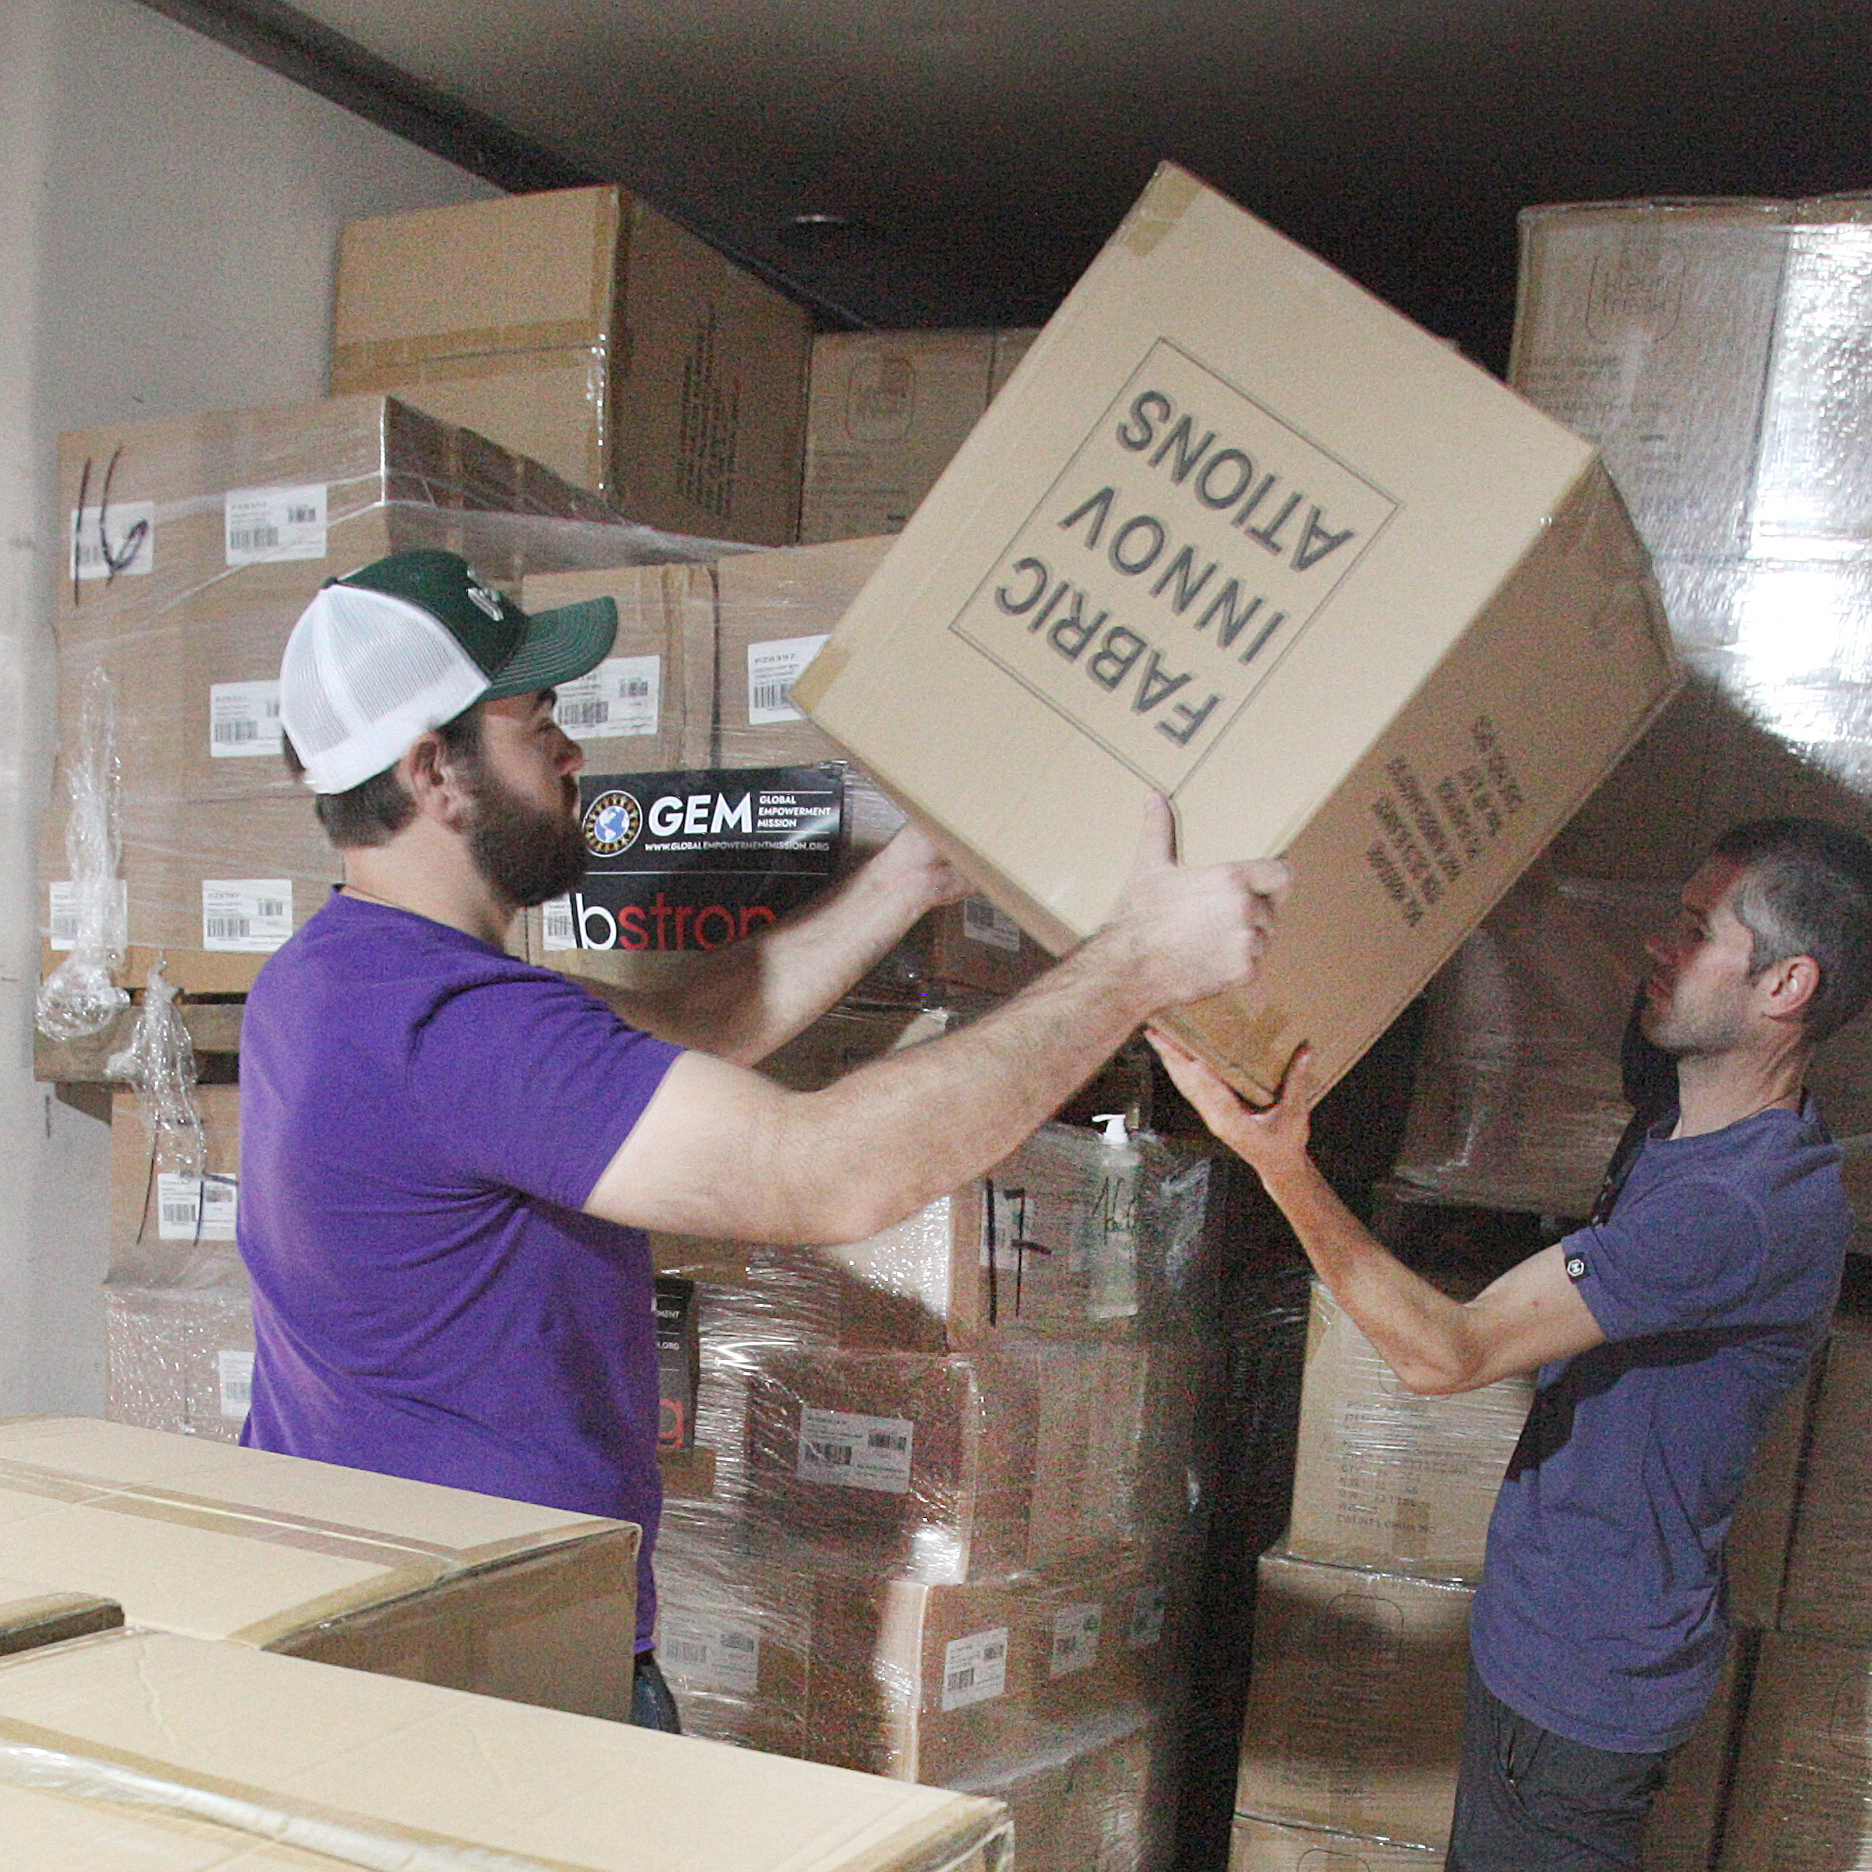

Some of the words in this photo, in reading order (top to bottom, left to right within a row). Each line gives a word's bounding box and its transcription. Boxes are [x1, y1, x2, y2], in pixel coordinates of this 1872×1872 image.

[1116, 389, 1354, 572] ATIONS
[1060, 484, 1287, 665] INNOV
[994, 556, 1225, 748] FABRIC
[648, 791, 752, 837] GEM
[757, 818, 797, 828] MISSION
[758, 806, 830, 817] EMPOWERMENT
[759, 795, 796, 805] GLOBAL
[574, 891, 776, 950] bstron
